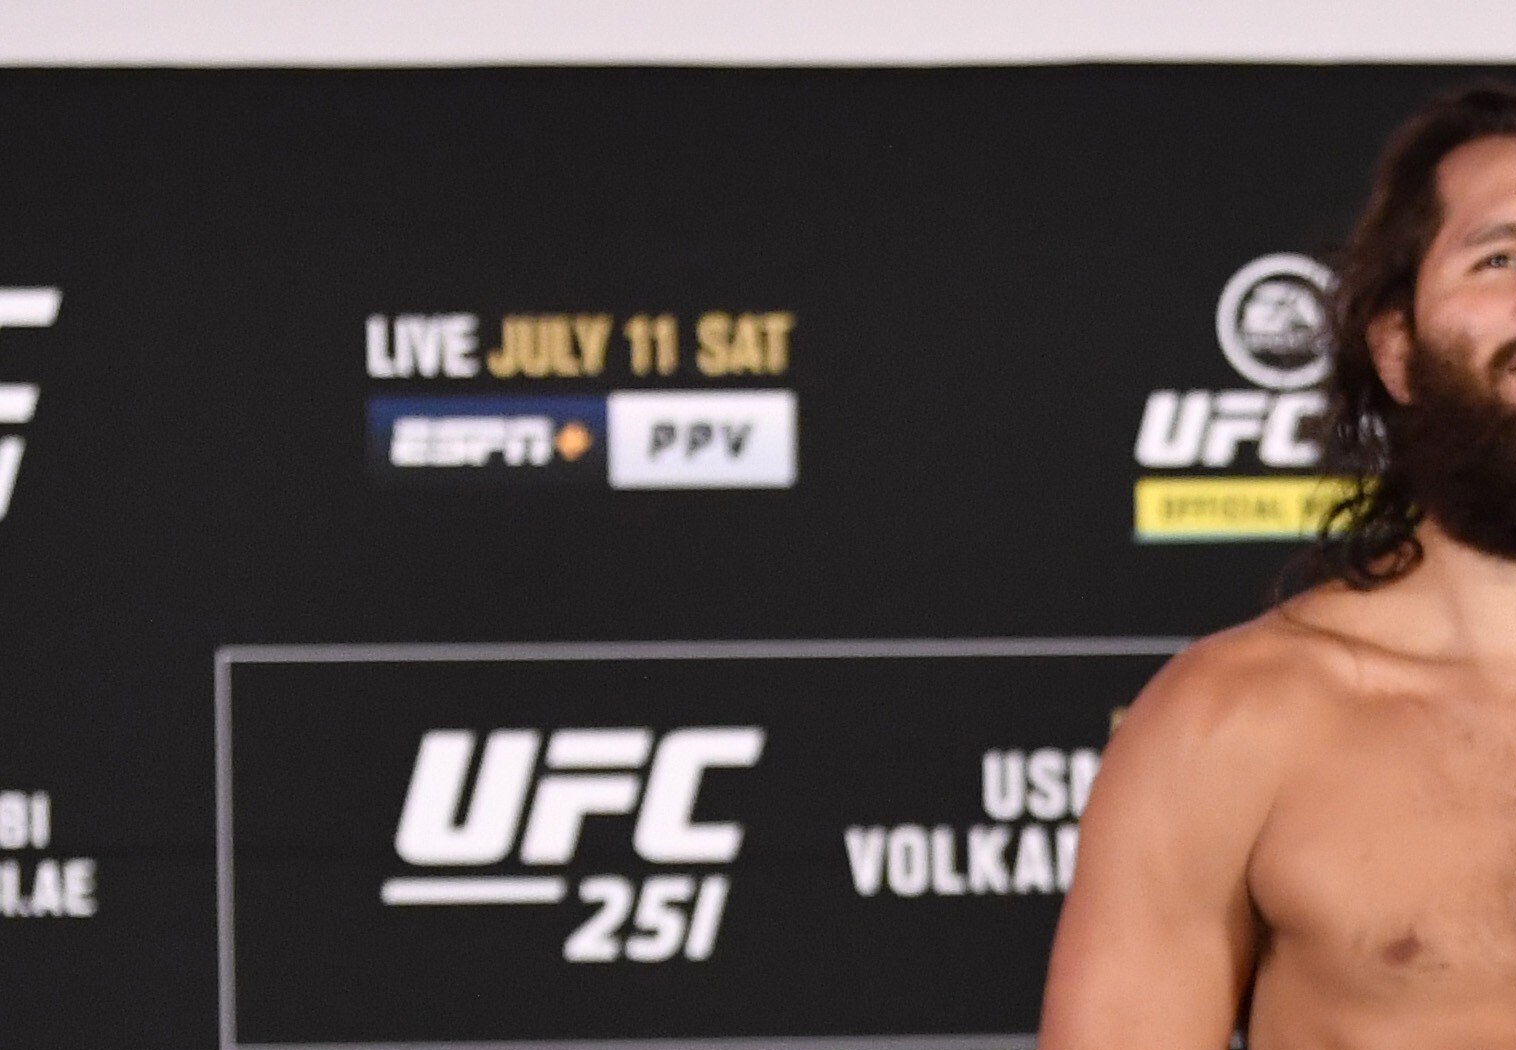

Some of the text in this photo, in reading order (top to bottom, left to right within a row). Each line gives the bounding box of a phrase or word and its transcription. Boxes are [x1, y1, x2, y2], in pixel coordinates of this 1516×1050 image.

[366, 312, 794, 378] LIVE JULY 11 SAT
[647, 419, 753, 462] PPV
[1134, 388, 1328, 468] UFC
[395, 727, 765, 866] UFC
[562, 875, 729, 963] 251
